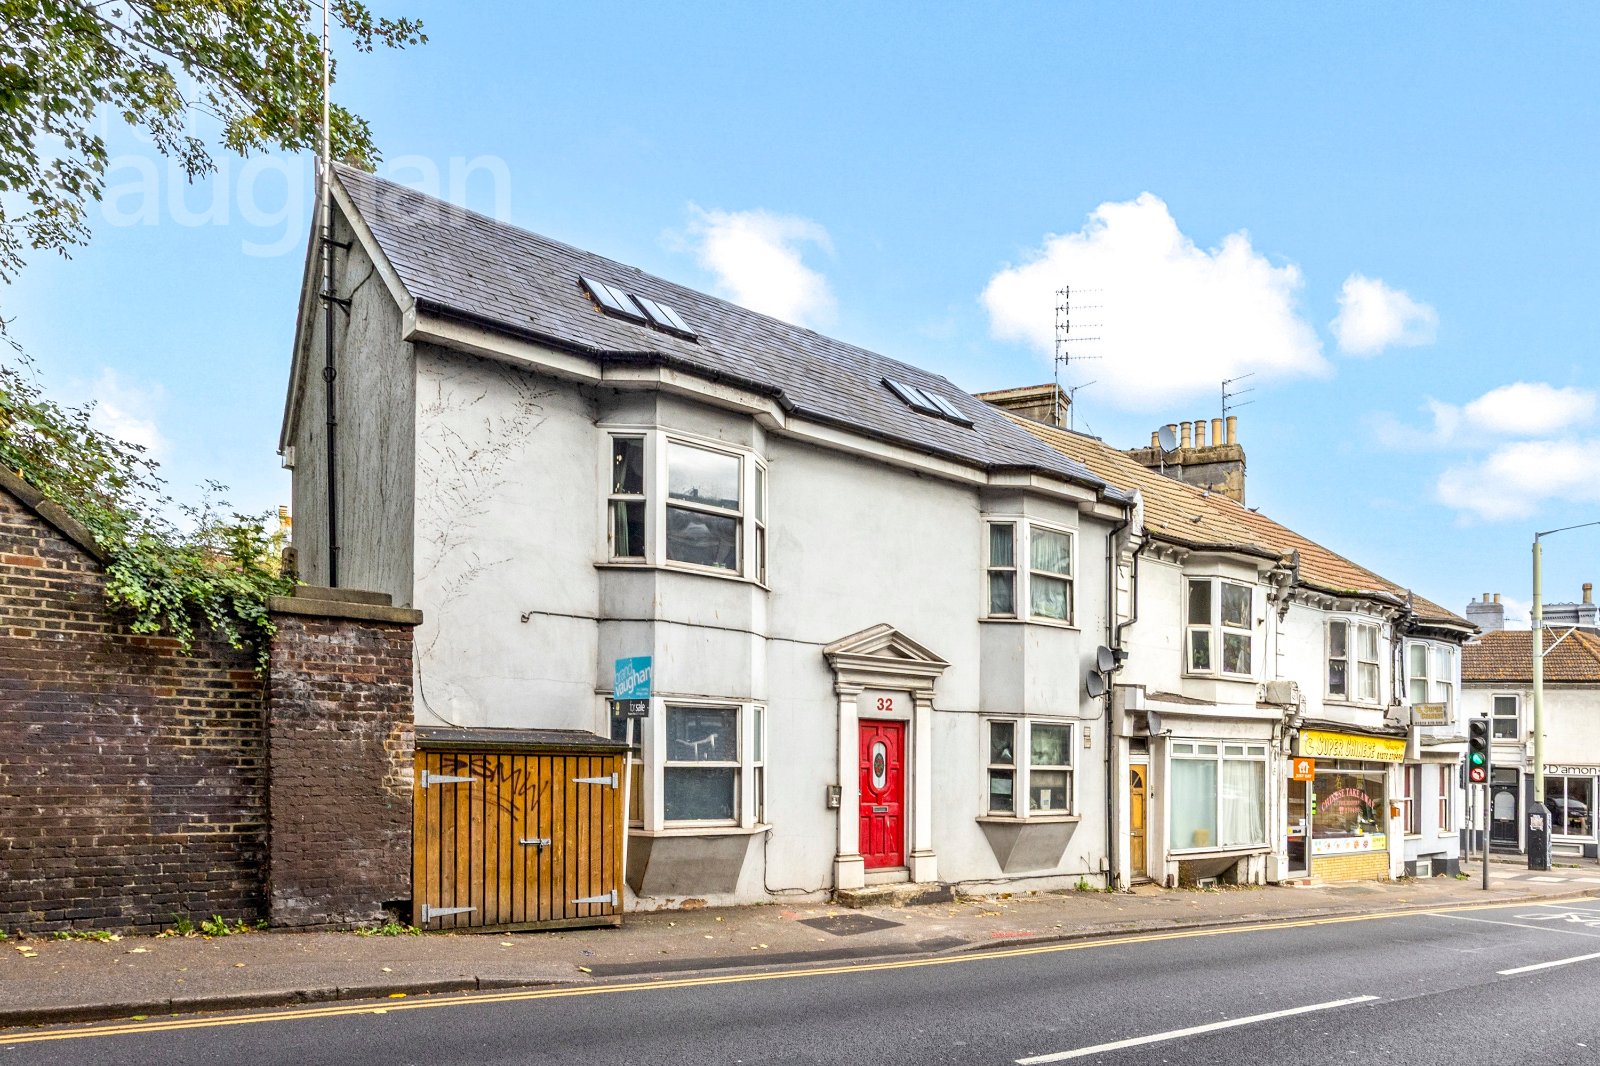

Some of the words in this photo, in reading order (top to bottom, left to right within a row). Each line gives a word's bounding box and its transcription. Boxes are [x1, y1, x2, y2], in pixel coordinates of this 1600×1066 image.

[616, 666, 652, 697] vaughan
[636, 701, 645, 711] sale
[877, 698, 893, 711] 32
[1316, 734, 1343, 756] SUPER
[1345, 736, 1375, 758] CHINESE
[1321, 788, 1345, 811] CHINESE
[1345, 788, 1360, 798] TAKE
